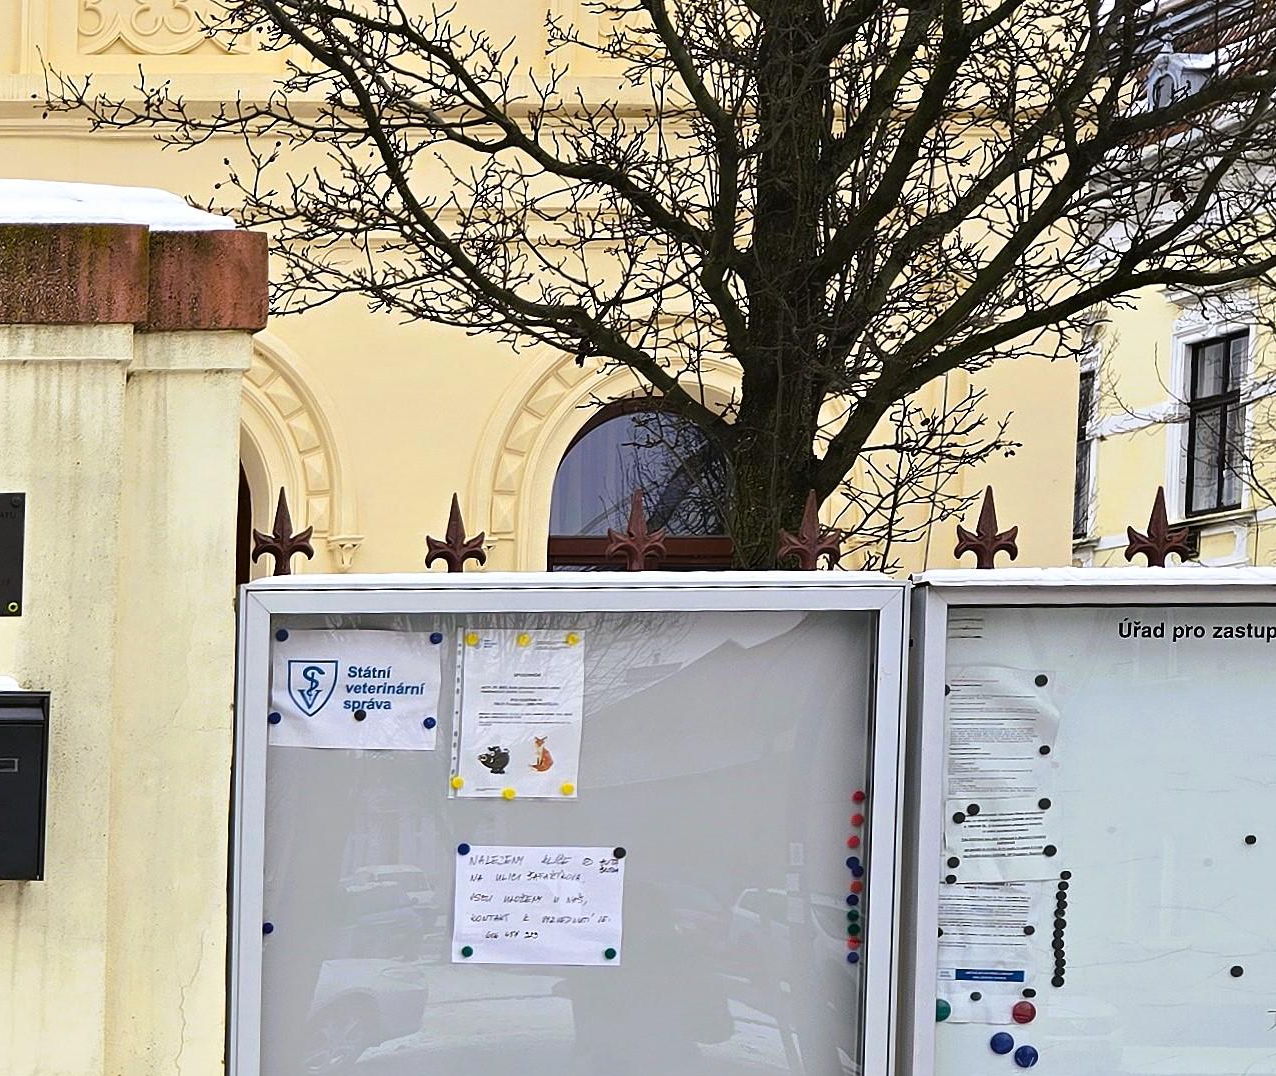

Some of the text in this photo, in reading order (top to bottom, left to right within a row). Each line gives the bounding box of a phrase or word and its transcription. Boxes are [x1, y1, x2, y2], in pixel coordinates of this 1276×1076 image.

[1118, 618, 1276, 643] Úřad pro zastup
[347, 666, 393, 679] Státní
[345, 681, 426, 696] veterinární
[343, 698, 392, 713] správa
